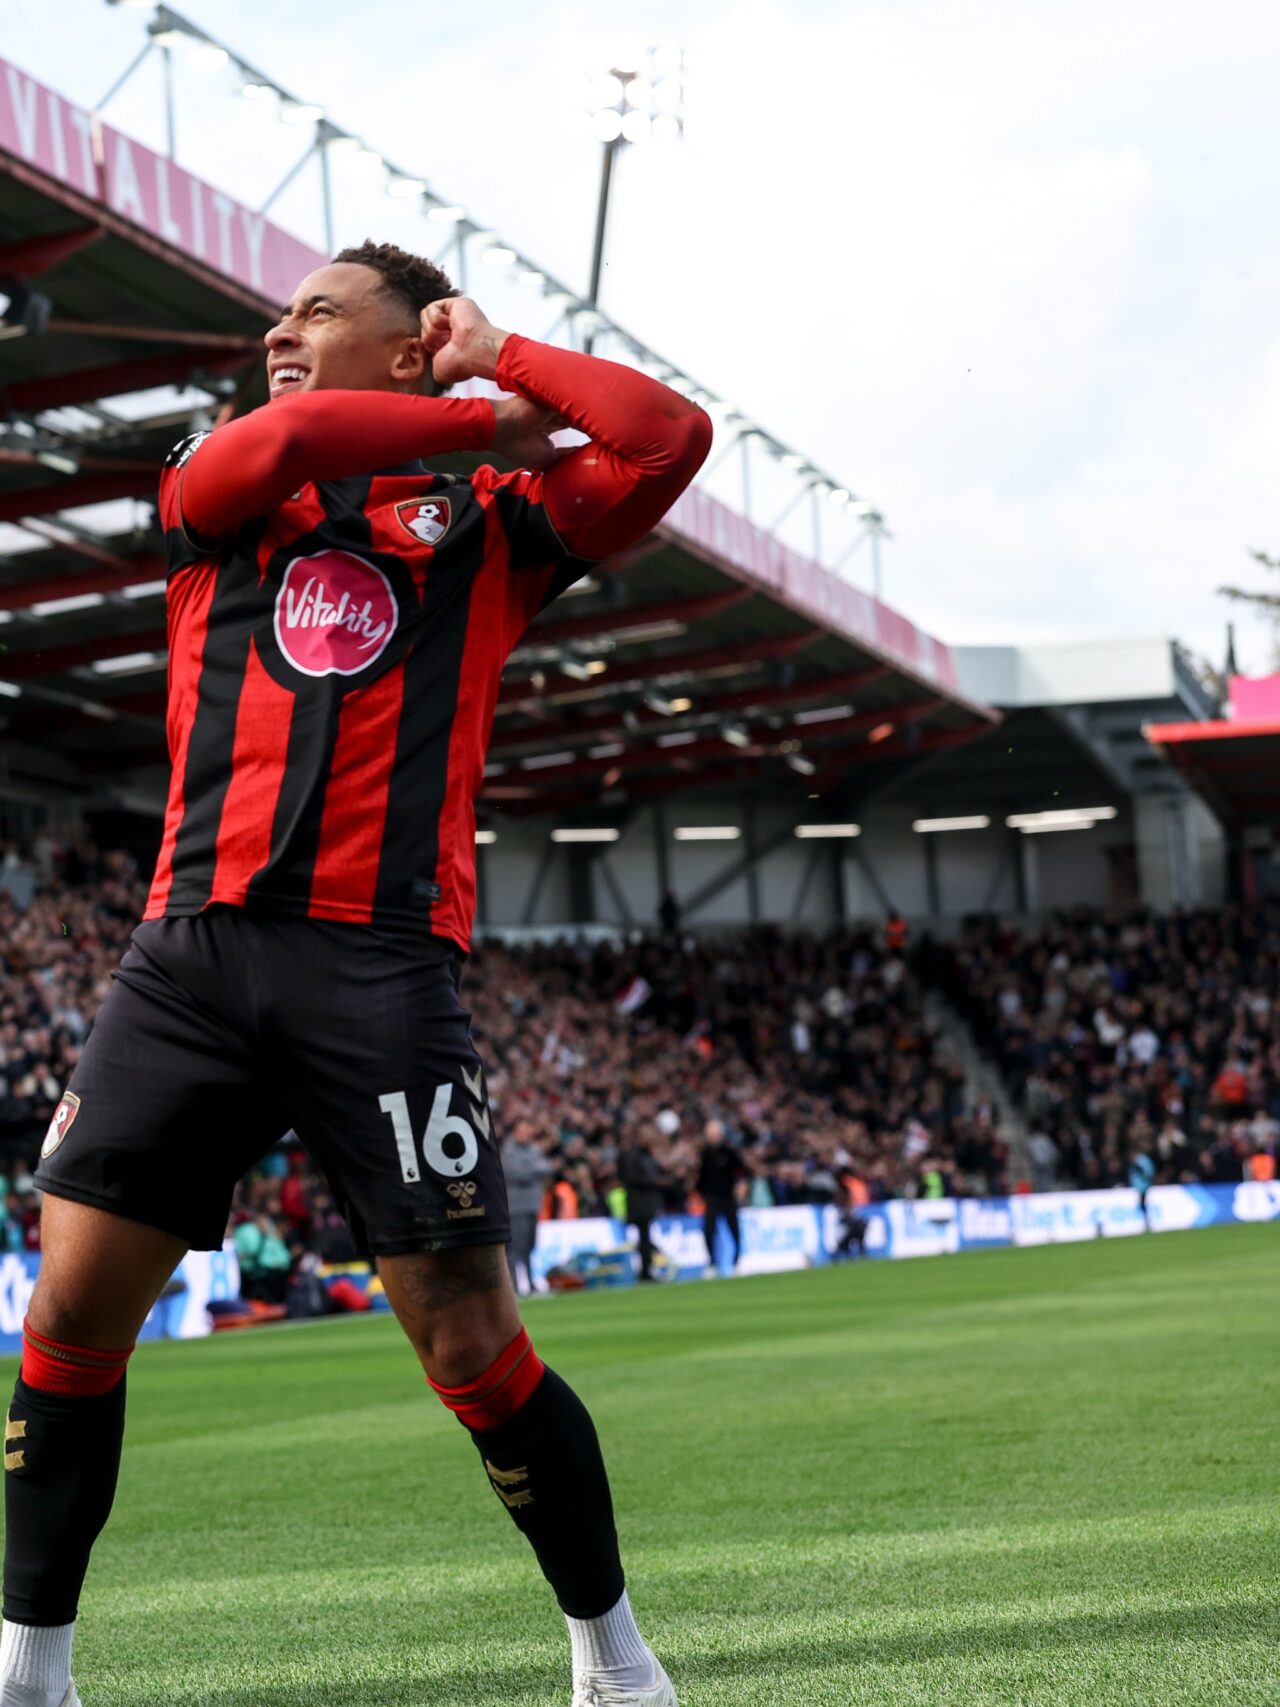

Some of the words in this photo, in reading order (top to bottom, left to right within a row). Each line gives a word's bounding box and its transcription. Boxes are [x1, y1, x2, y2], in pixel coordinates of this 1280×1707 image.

[5, 67, 266, 288] VITALITY
[286, 576, 387, 650] Vitality
[378, 1082, 478, 1183] 16
